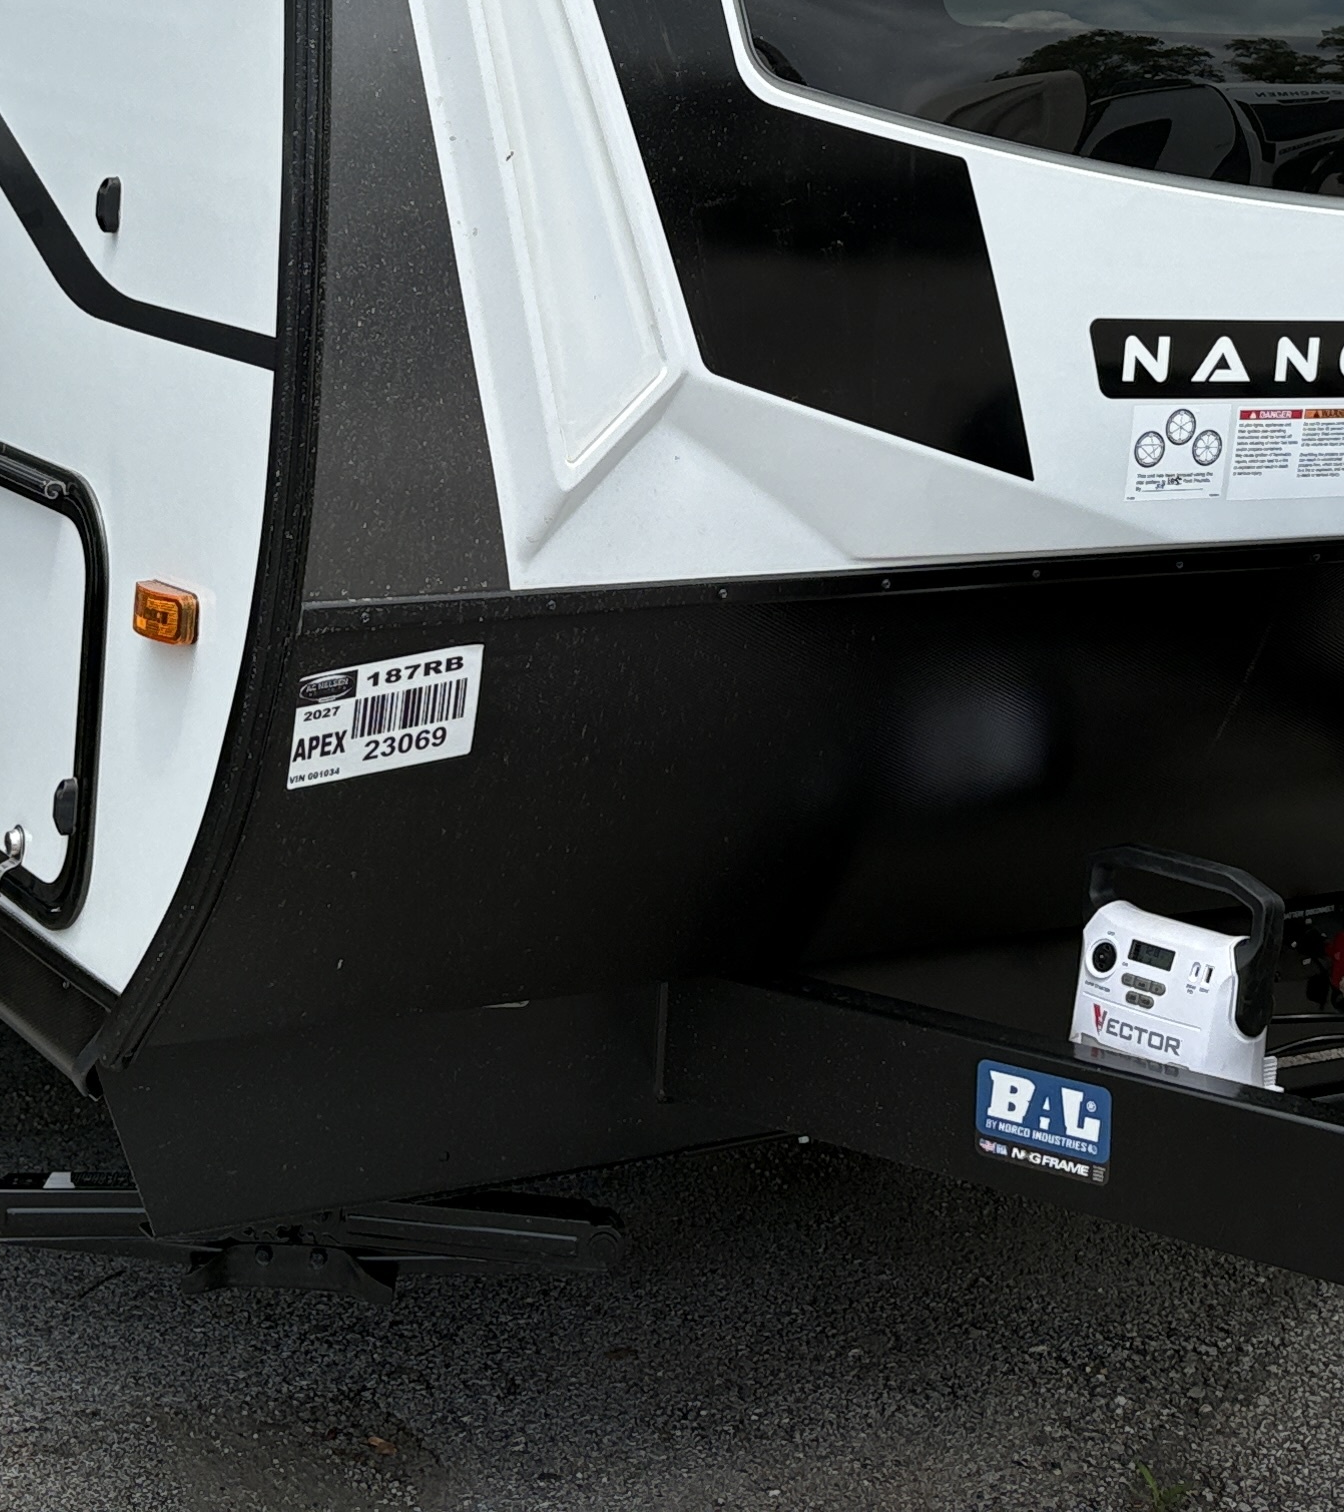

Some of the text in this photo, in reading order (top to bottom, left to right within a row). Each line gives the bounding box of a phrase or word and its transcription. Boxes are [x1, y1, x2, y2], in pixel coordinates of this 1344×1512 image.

[1258, 410, 1293, 419] DANGER
[366, 656, 464, 687] 187RB
[303, 706, 340, 722] 2027
[292, 729, 347, 763] APEX
[362, 726, 447, 762] 23069
[289, 773, 305, 785] VIN
[1093, 1003, 1182, 1057] VECTOR
[987, 1069, 1101, 1143] BAL
[986, 1118, 1087, 1153] BY NORCO INDUSTRIES
[1041, 1152, 1089, 1176] FRAME
